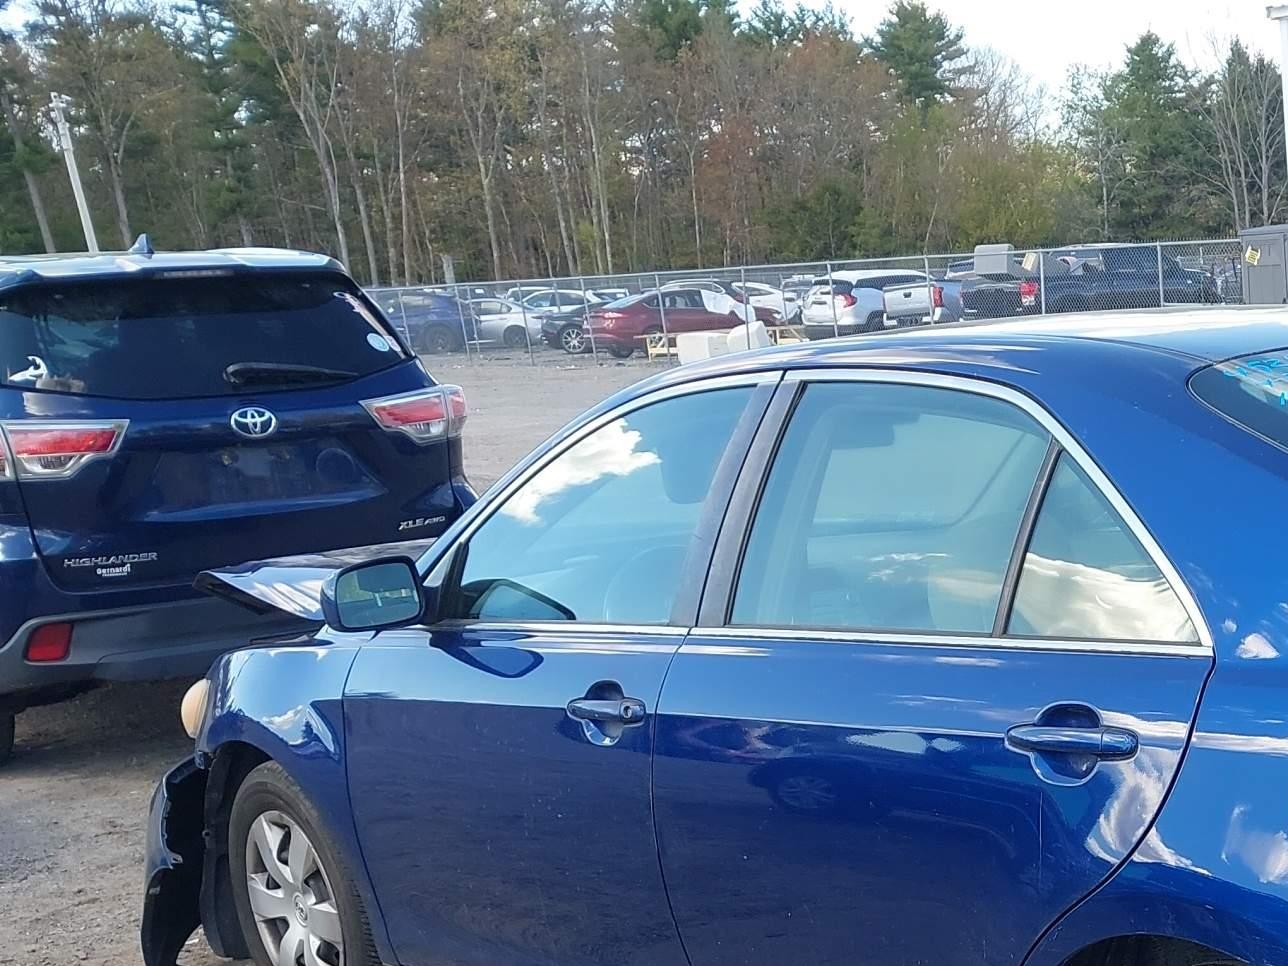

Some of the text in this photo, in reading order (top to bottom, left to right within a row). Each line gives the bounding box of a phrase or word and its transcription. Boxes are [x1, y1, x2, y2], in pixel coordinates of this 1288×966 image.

[398, 517, 425, 531] XLE
[63, 551, 158, 568] HIGHLANDER
[96, 563, 131, 575] Bernardi
